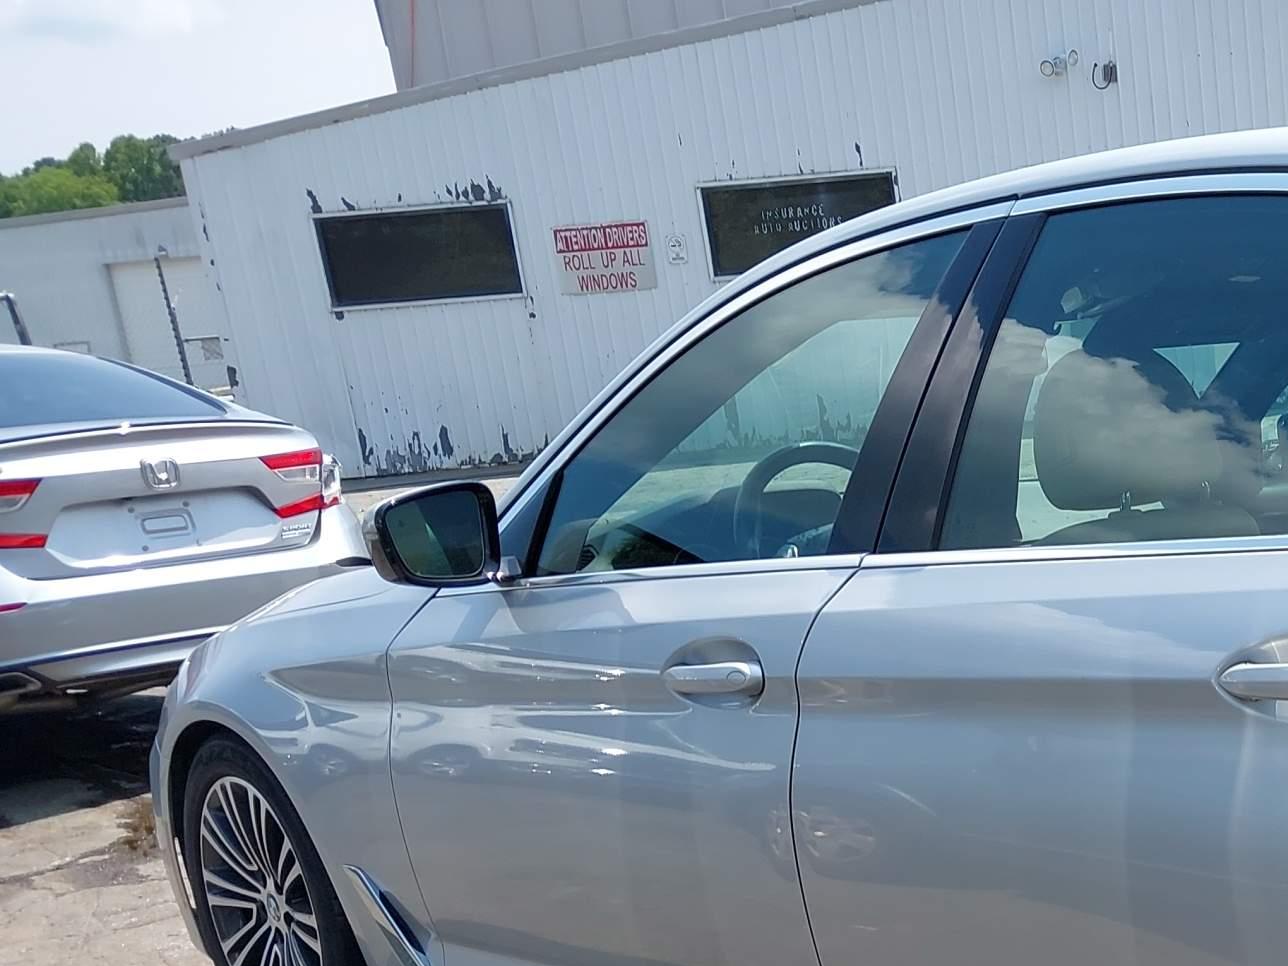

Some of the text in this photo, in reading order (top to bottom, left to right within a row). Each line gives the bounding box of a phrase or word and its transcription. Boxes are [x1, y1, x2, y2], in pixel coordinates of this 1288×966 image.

[761, 203, 825, 220] INSURANCE
[556, 225, 647, 251] ATTENTION DRIVERS
[563, 248, 646, 272] ROLL UP ALL
[577, 271, 637, 292] WINDOWS
